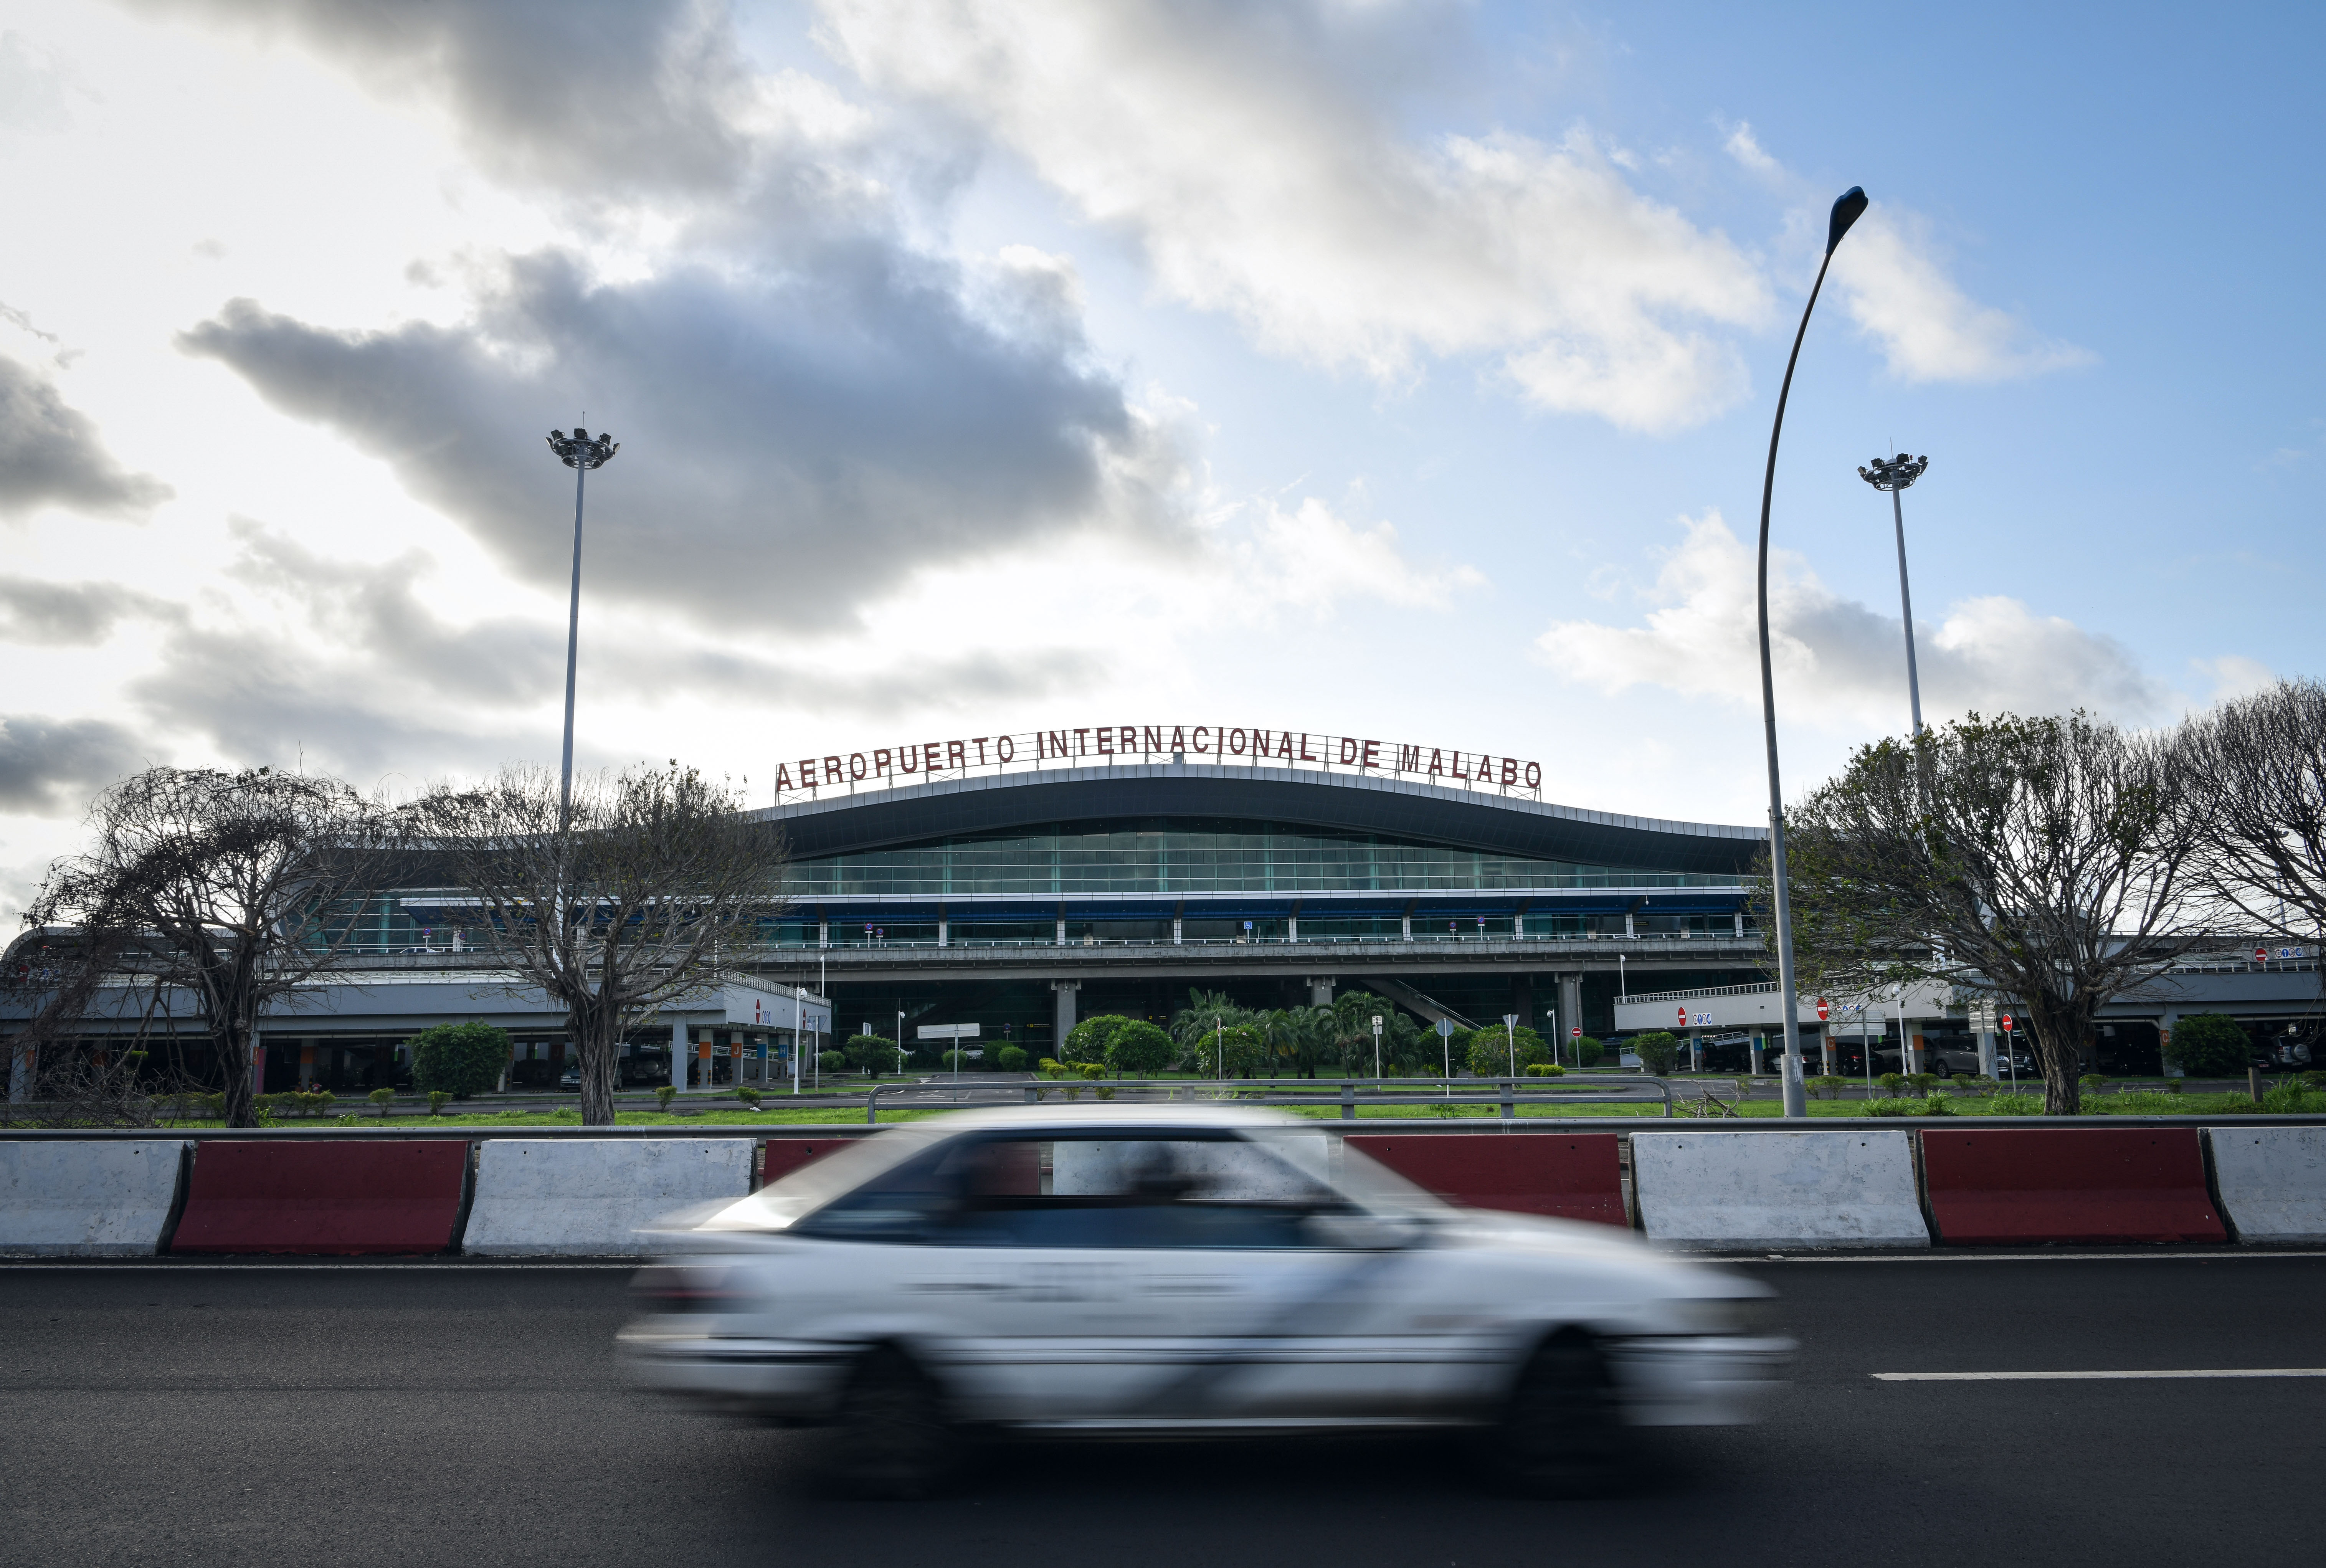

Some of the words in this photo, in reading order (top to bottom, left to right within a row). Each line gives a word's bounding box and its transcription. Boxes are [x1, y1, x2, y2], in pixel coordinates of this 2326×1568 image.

[777, 735, 1014, 791] AEROPUERTO
[1038, 725, 1317, 762] INTERNACIONAL
[1340, 737, 1380, 768] DE
[1403, 744, 1541, 788] MALABO
[2162, 1033, 2168, 1042] C
[1827, 1039, 1834, 1048] C
[553, 1049, 559, 1057] J
[734, 1046, 739, 1055] J
